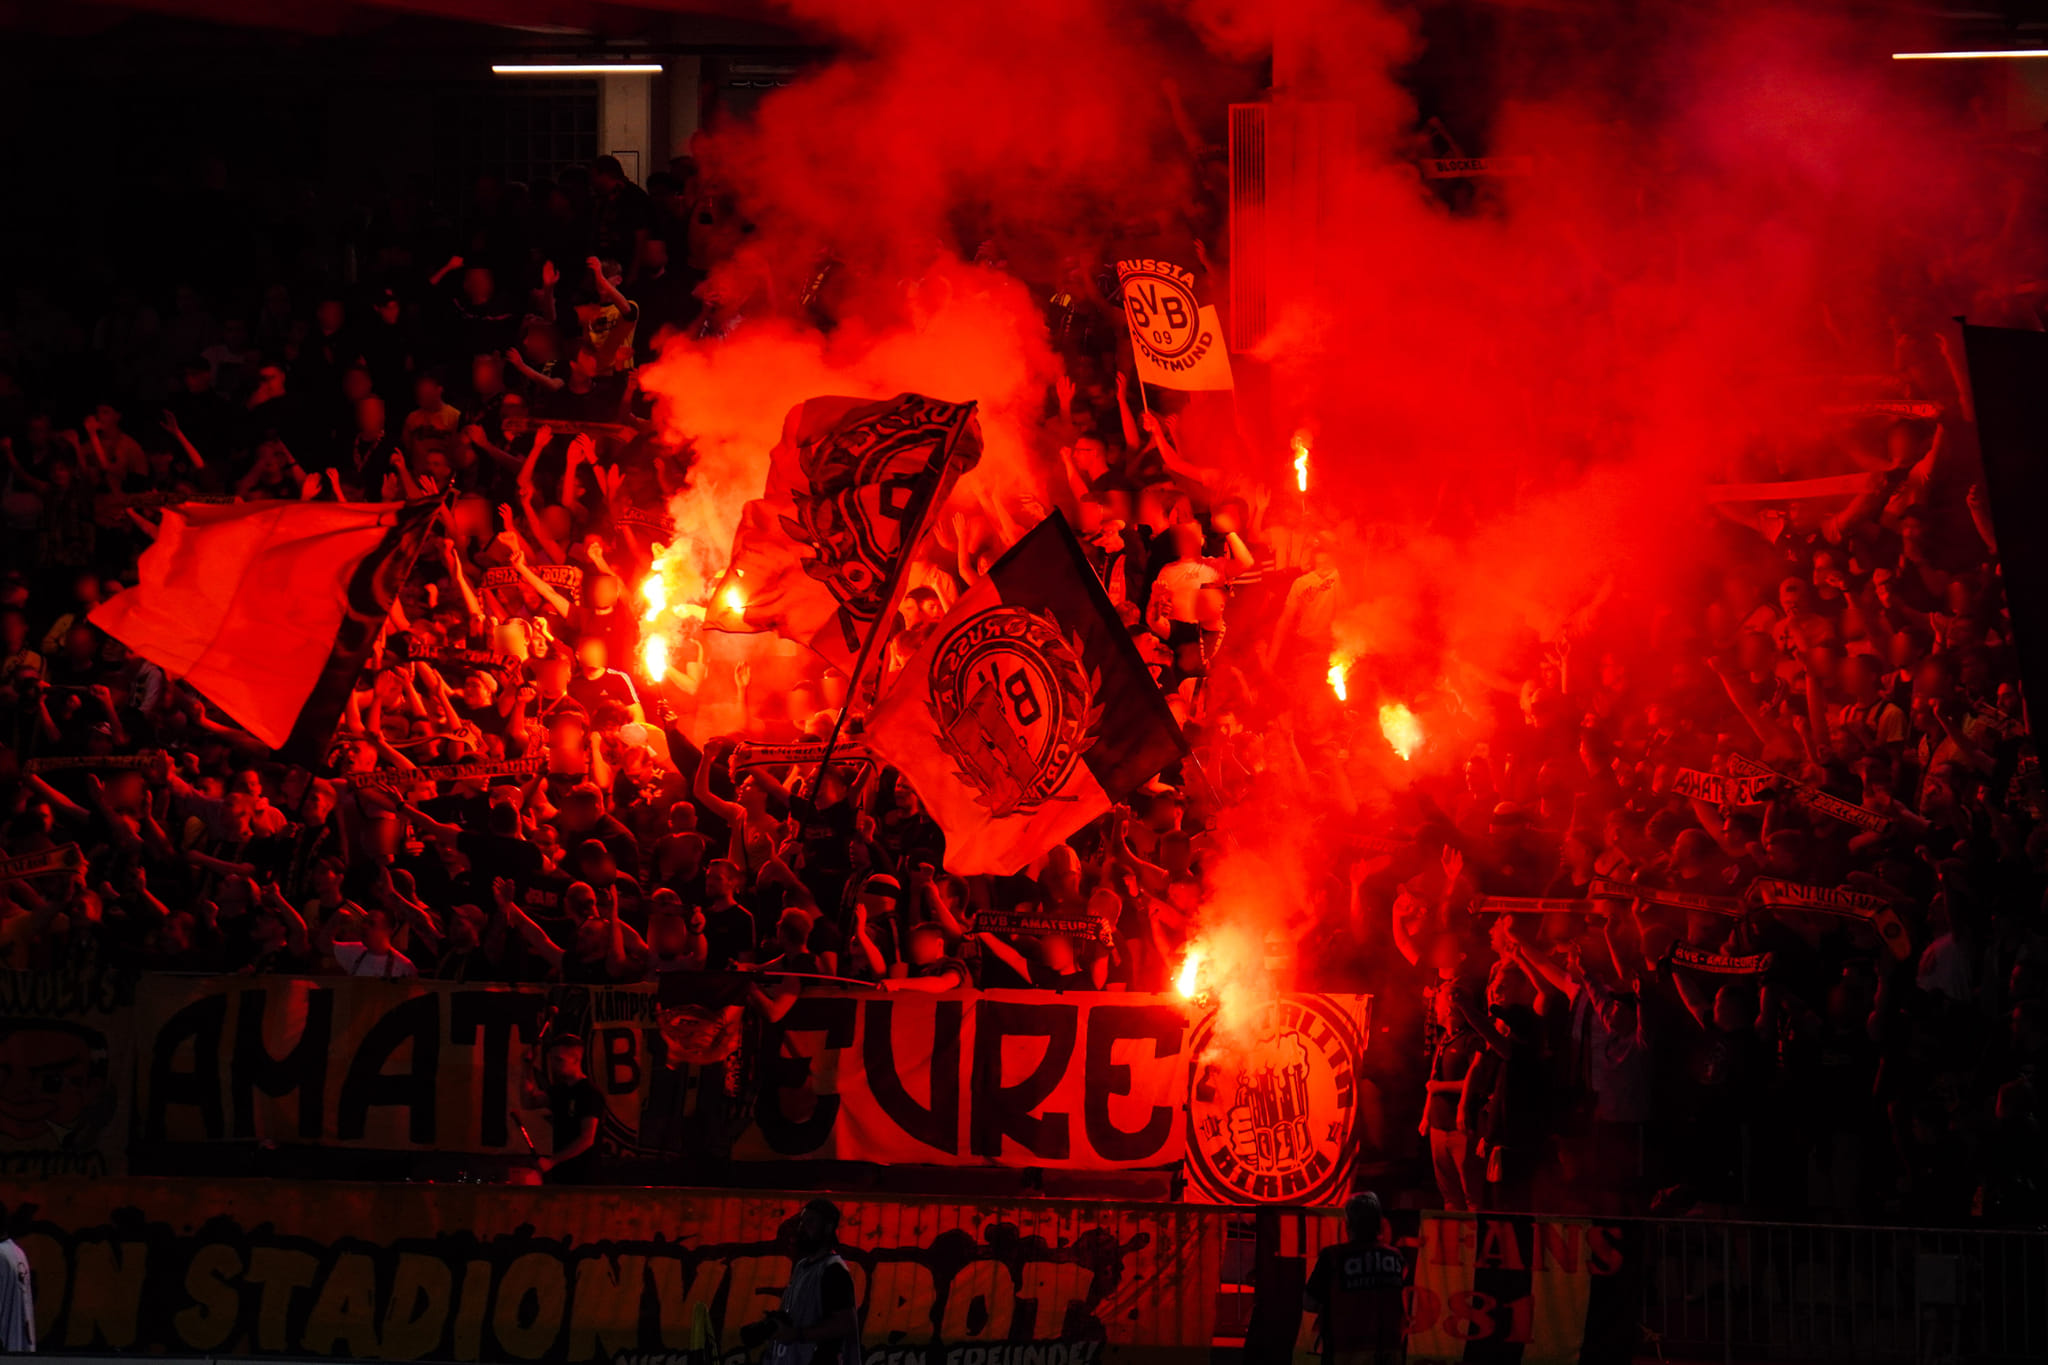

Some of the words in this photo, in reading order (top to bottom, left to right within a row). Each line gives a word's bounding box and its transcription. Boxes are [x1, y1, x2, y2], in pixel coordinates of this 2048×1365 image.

[1128, 283, 1188, 330] BVB
[1152, 330, 1173, 345] 09
[978, 914, 1009, 927] BVB
[1020, 918, 1097, 934] AMATEURE
[172, 1241, 1095, 1362] STADIONVEBOT
